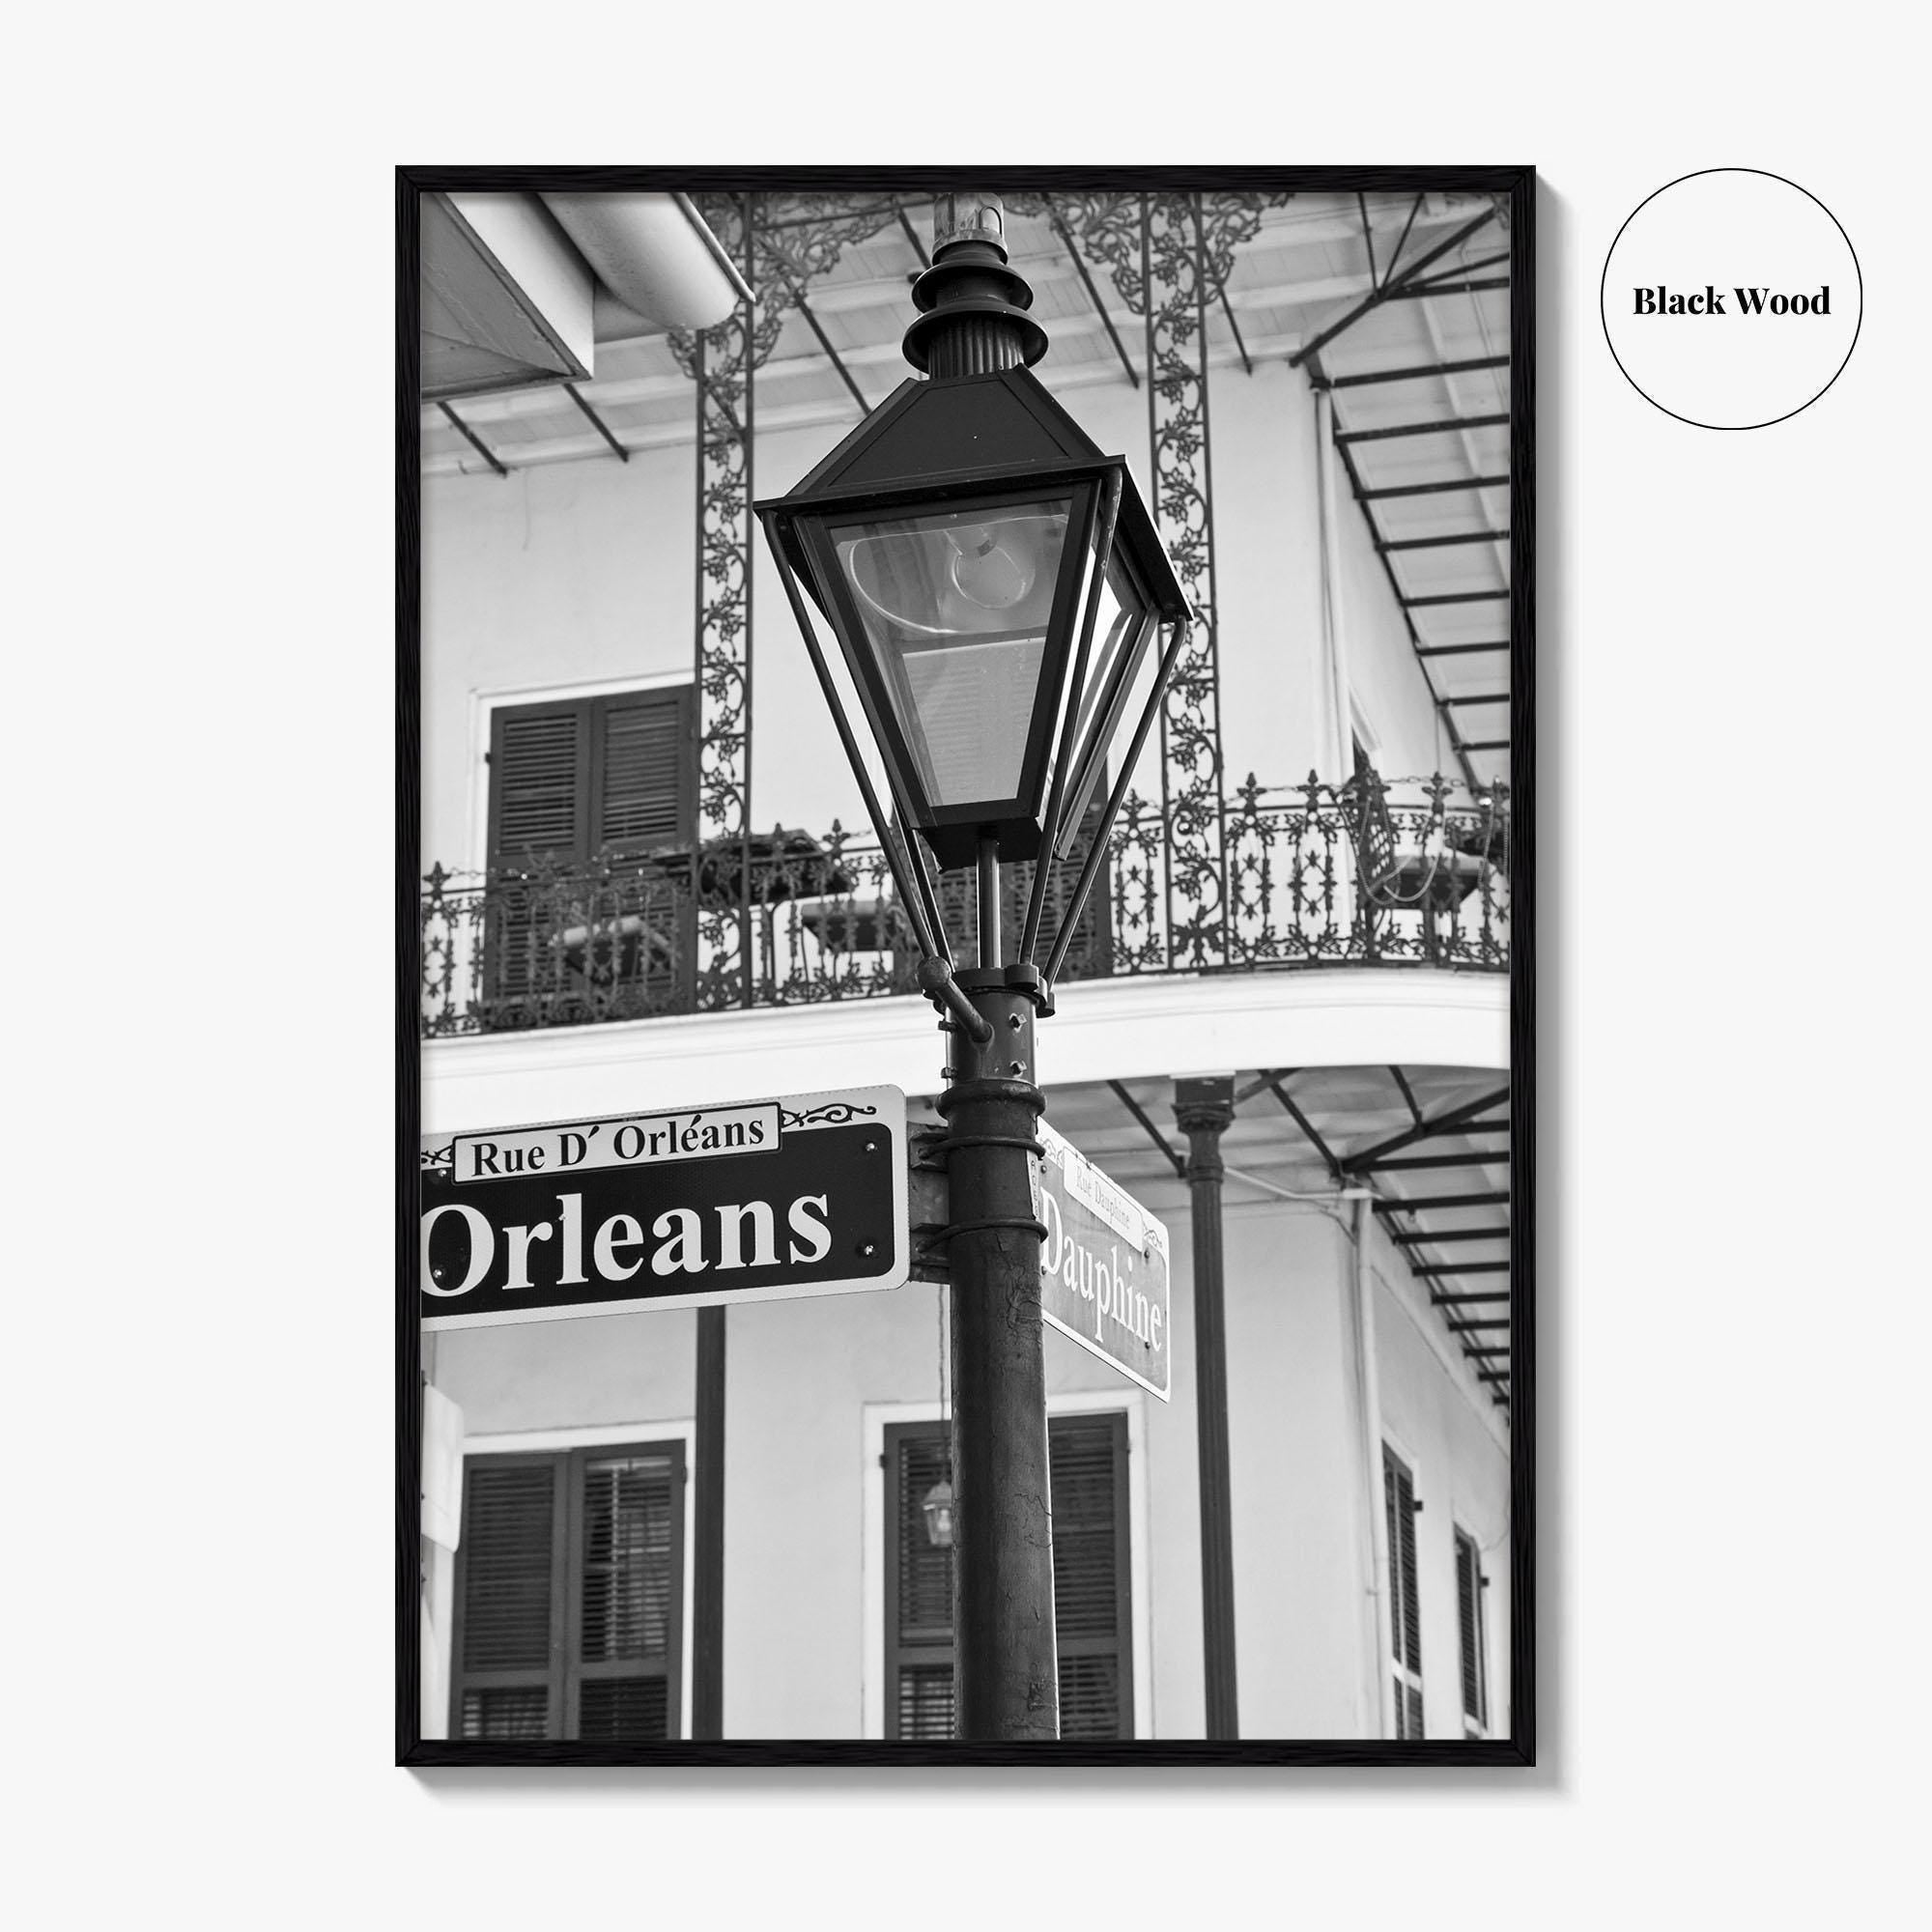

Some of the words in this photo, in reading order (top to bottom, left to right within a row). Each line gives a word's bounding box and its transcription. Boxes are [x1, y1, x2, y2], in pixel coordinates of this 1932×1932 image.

[470, 1143, 545, 1177] Rue
[612, 1114, 765, 1159] Orléans
[1074, 1164, 1092, 1198] Rue
[1094, 1179, 1131, 1230] Dauphine
[421, 1192, 833, 1297] Orleans
[1040, 1185, 1162, 1352] Dauphine
